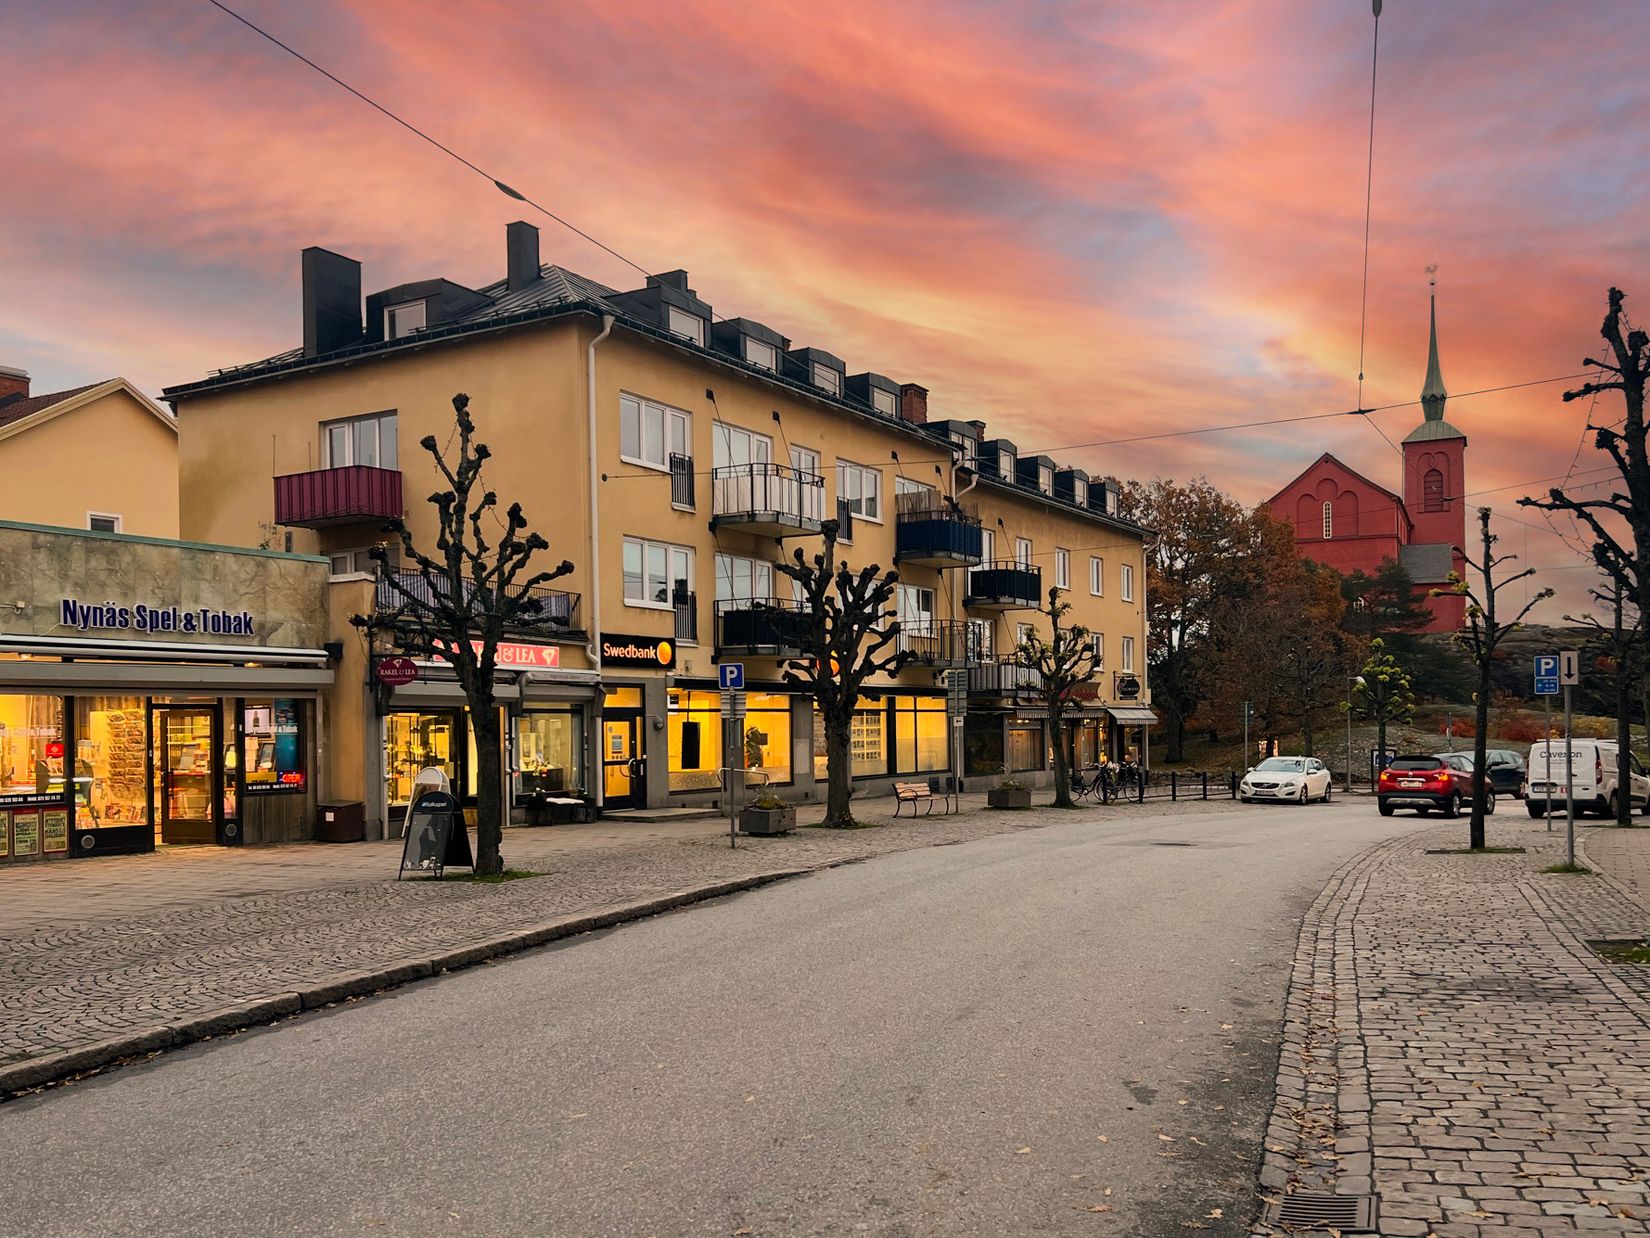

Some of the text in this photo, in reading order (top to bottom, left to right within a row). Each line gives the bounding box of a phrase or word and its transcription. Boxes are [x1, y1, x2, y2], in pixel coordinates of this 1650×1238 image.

[62, 599, 254, 635] Nynäs Spel & Tobak
[502, 648, 514, 663] &
[516, 648, 536, 664] LEA
[603, 643, 656, 659] Swedbank
[726, 666, 738, 686] P
[1541, 658, 1554, 676] P
